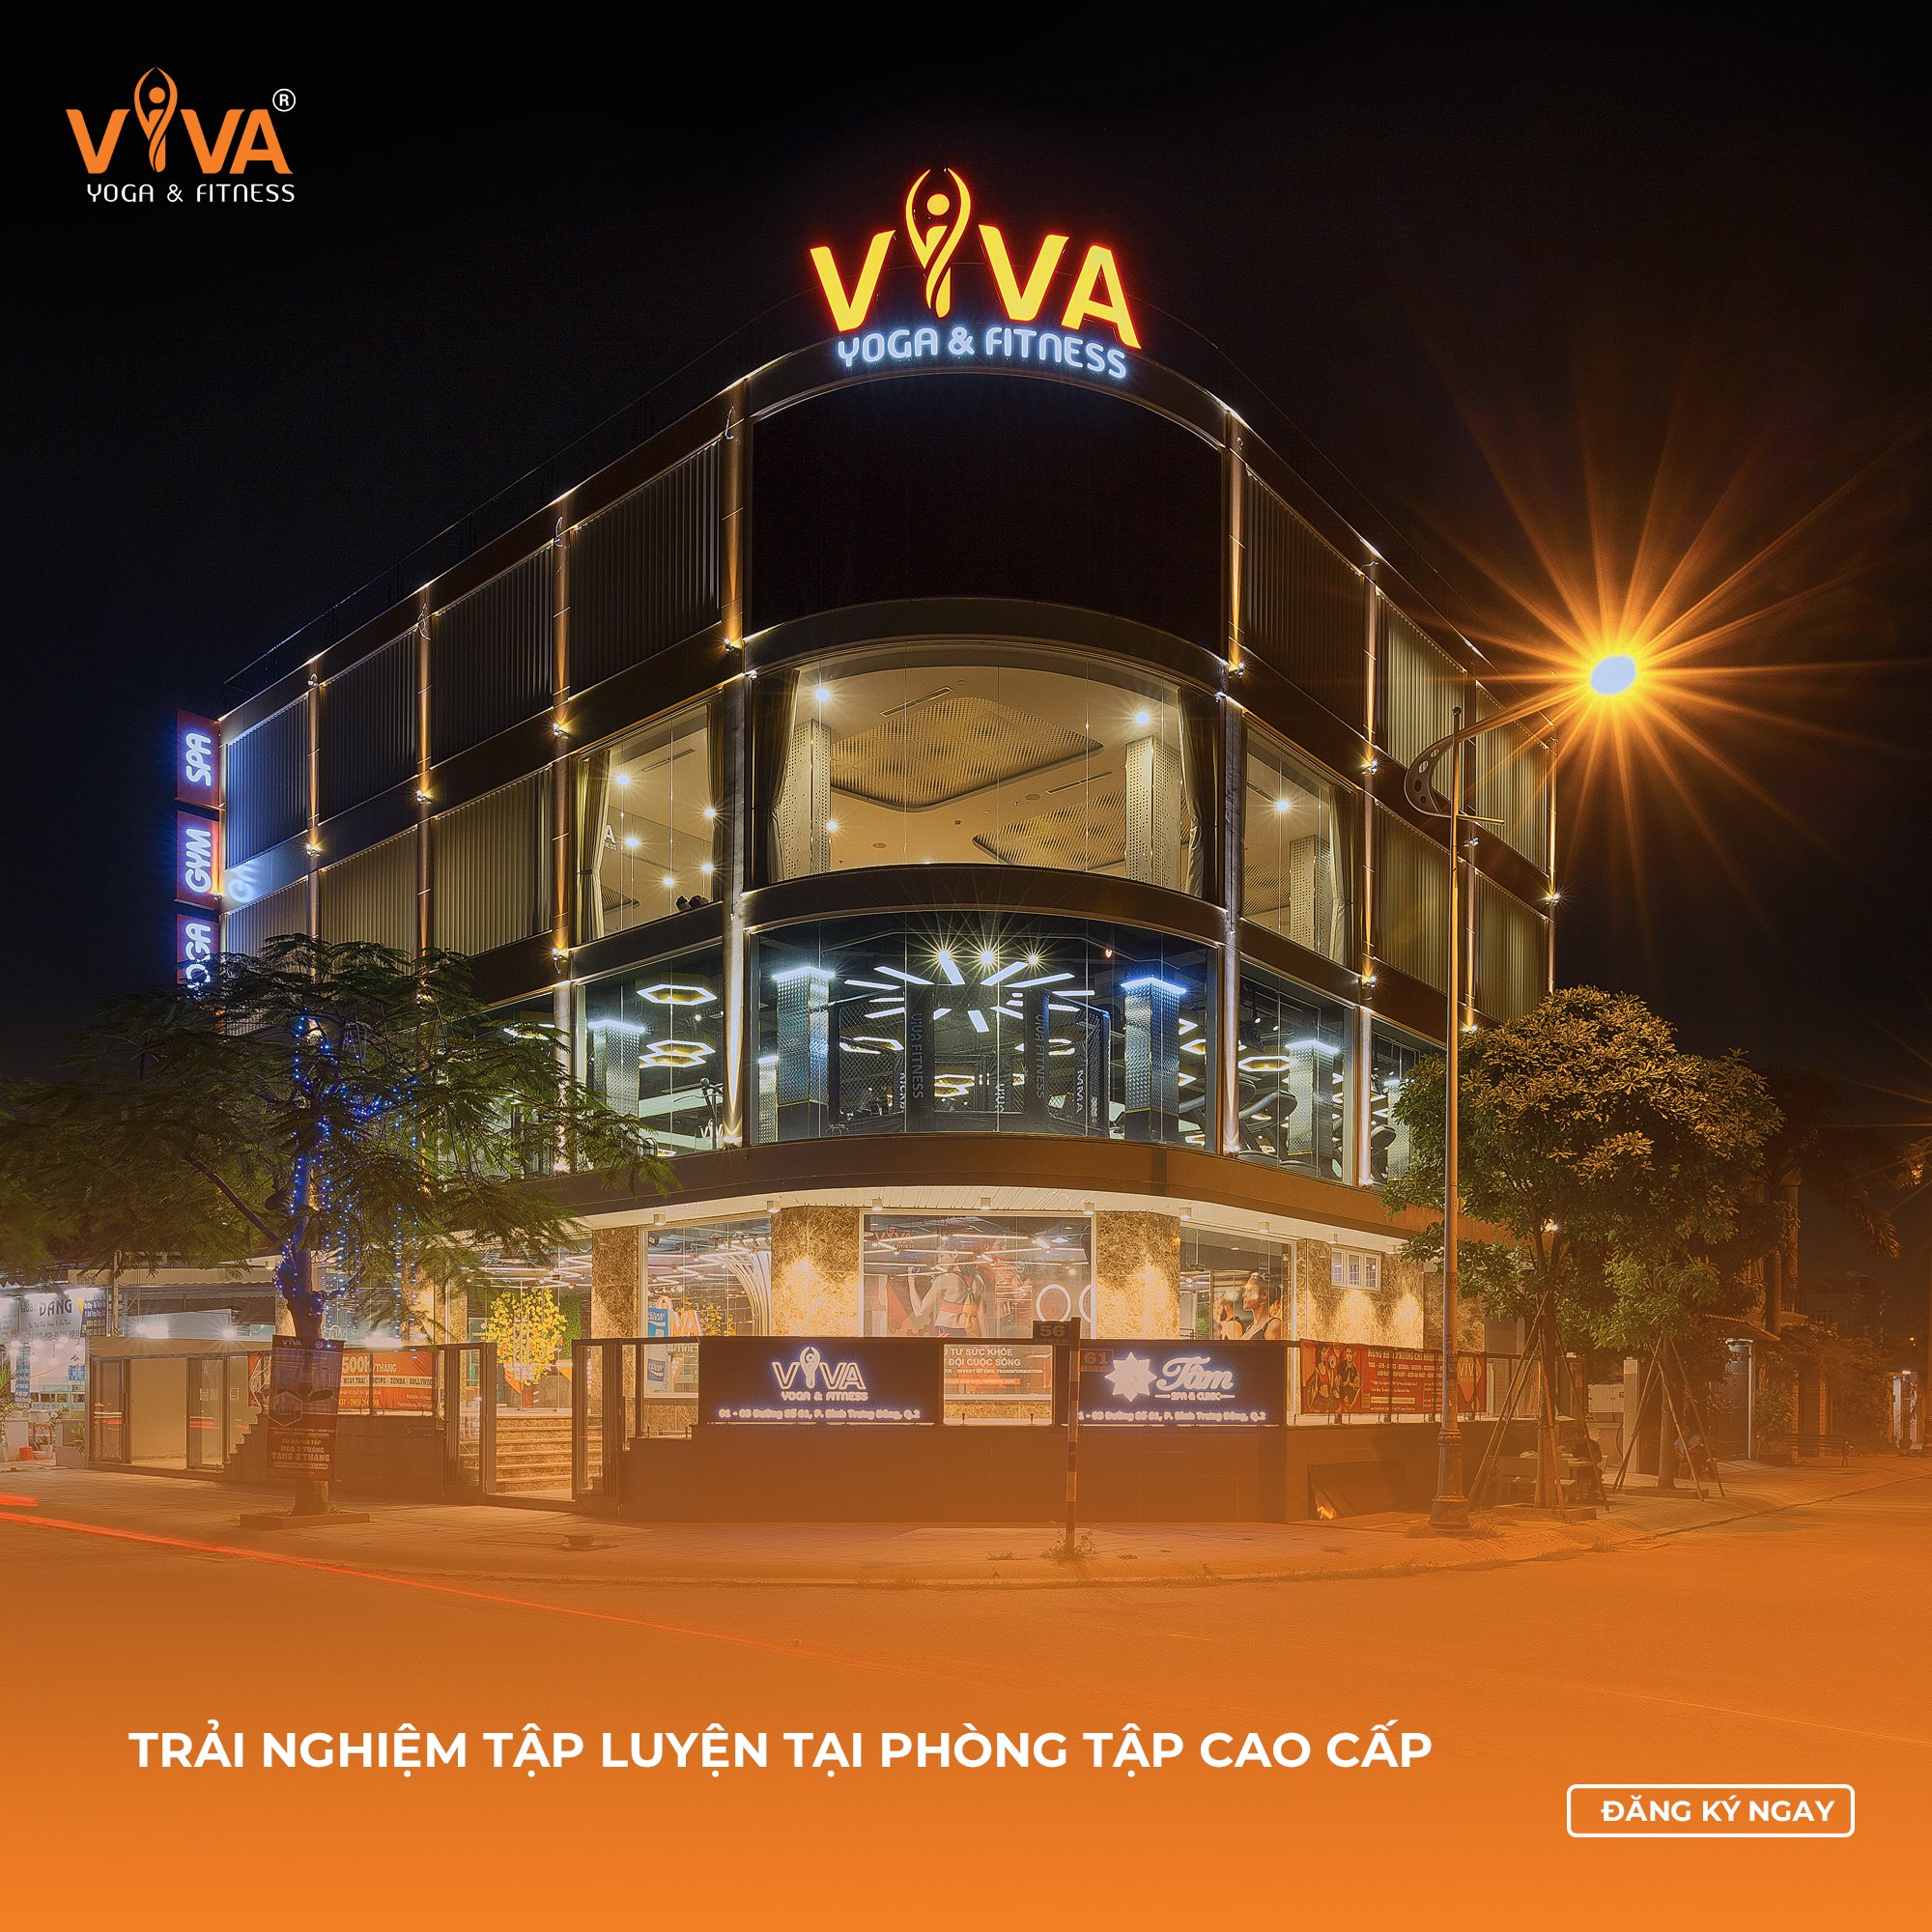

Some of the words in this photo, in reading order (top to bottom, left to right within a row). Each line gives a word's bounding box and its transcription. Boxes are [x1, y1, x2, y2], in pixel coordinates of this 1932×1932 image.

[810, 168, 1142, 350] VIVA
[836, 327, 939, 367] YOGA
[949, 327, 975, 355] &
[985, 326, 1128, 379] FITNESS
[185, 732, 212, 787] SPA
[185, 828, 213, 895] GYM
[911, 1044, 924, 1099] FITNESS
[1036, 1044, 1046, 1099] FITNESS
[966, 1348, 985, 1356] SỨC
[1039, 1325, 1065, 1337] 56
[772, 1346, 867, 1390] VIVA
[1084, 1352, 1108, 1365] 61
[1155, 1355, 1235, 1391] Tâm
[781, 1391, 811, 1402] YOGA
